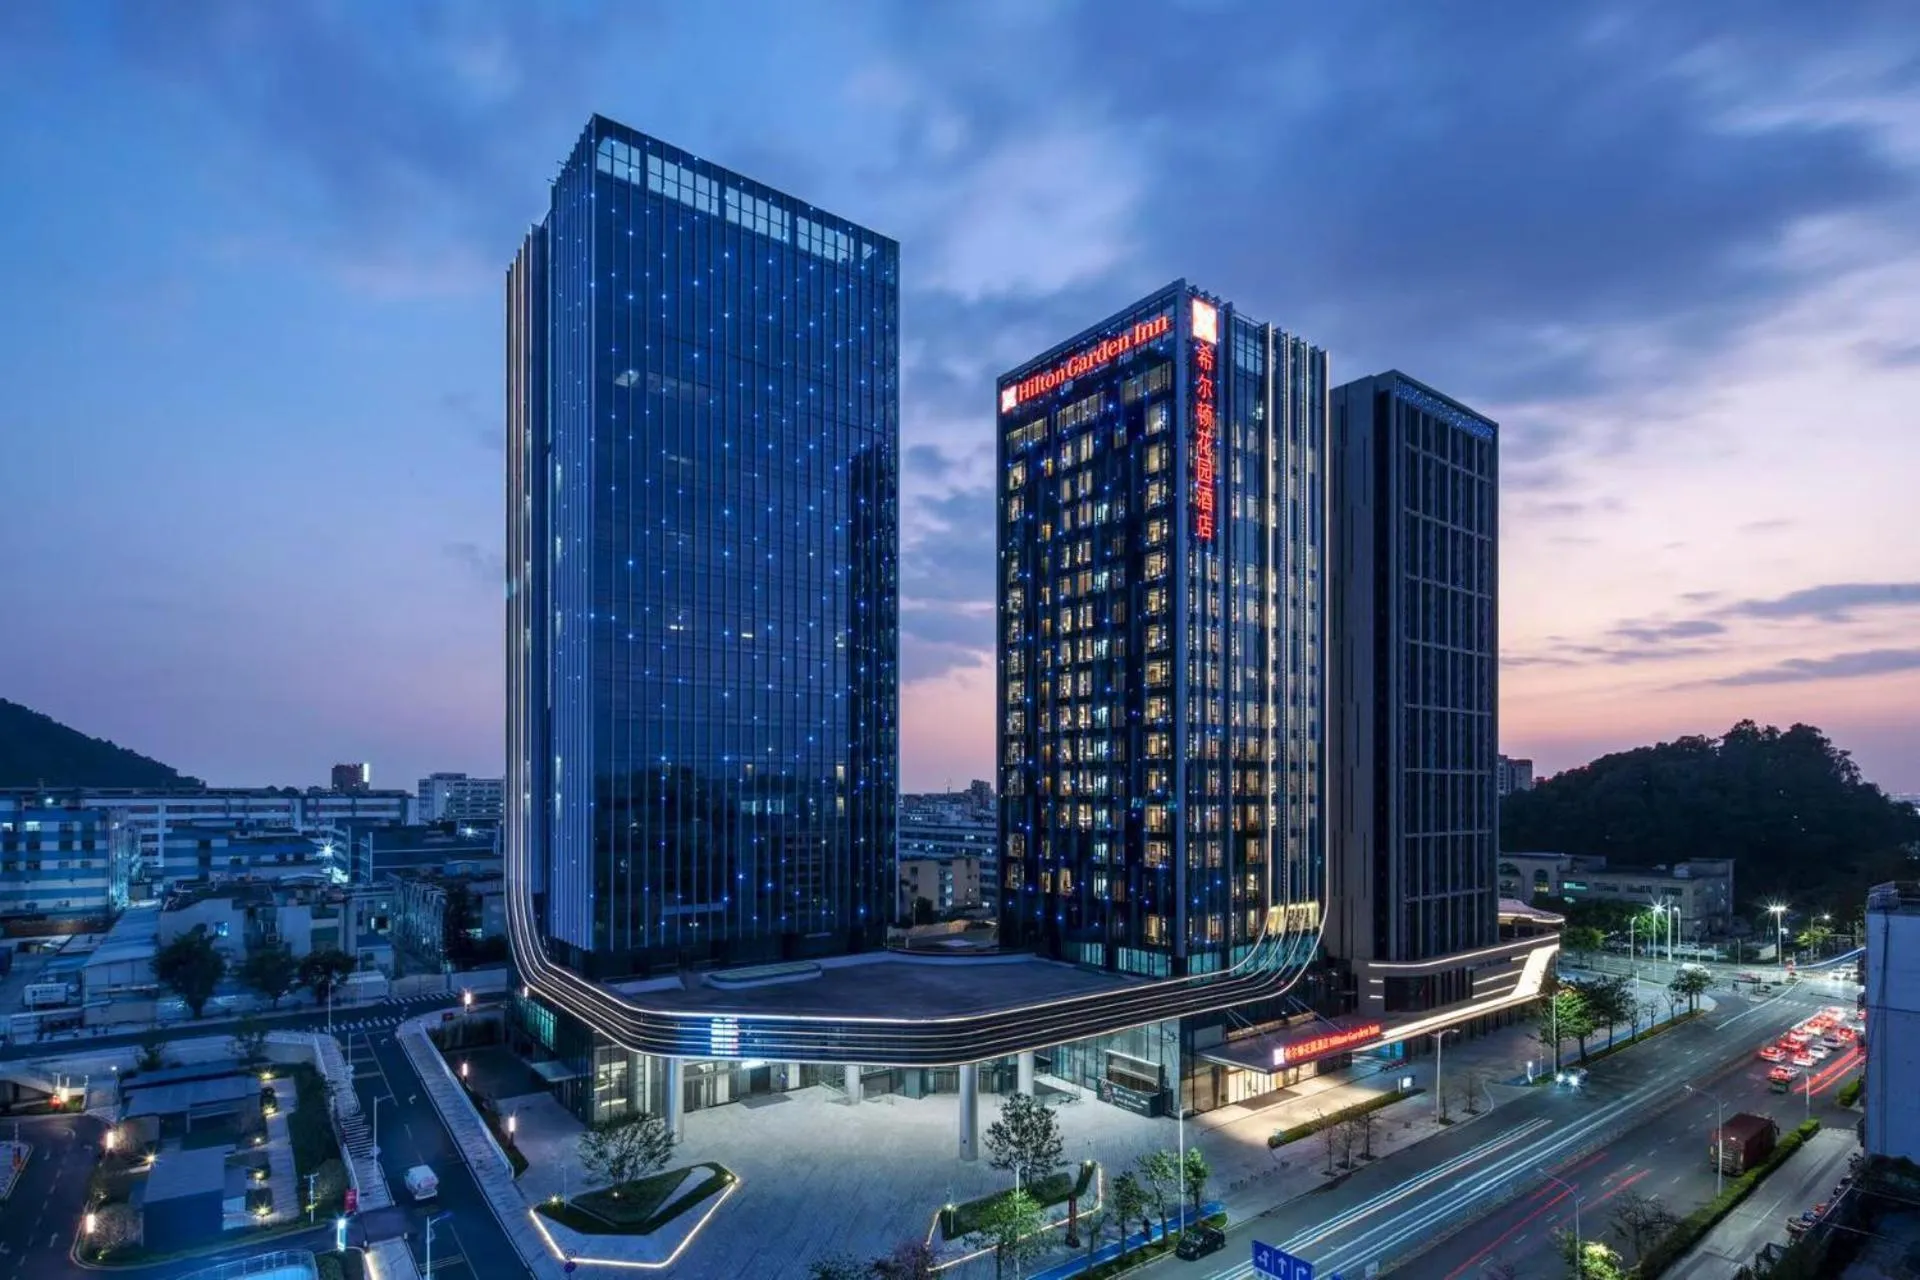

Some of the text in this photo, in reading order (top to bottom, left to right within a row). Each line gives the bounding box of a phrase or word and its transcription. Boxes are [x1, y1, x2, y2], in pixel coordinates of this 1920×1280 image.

[1018, 314, 1169, 402] Hilton Garden Inn
[1197, 342, 1213, 540] 希尔顿花园酒店
